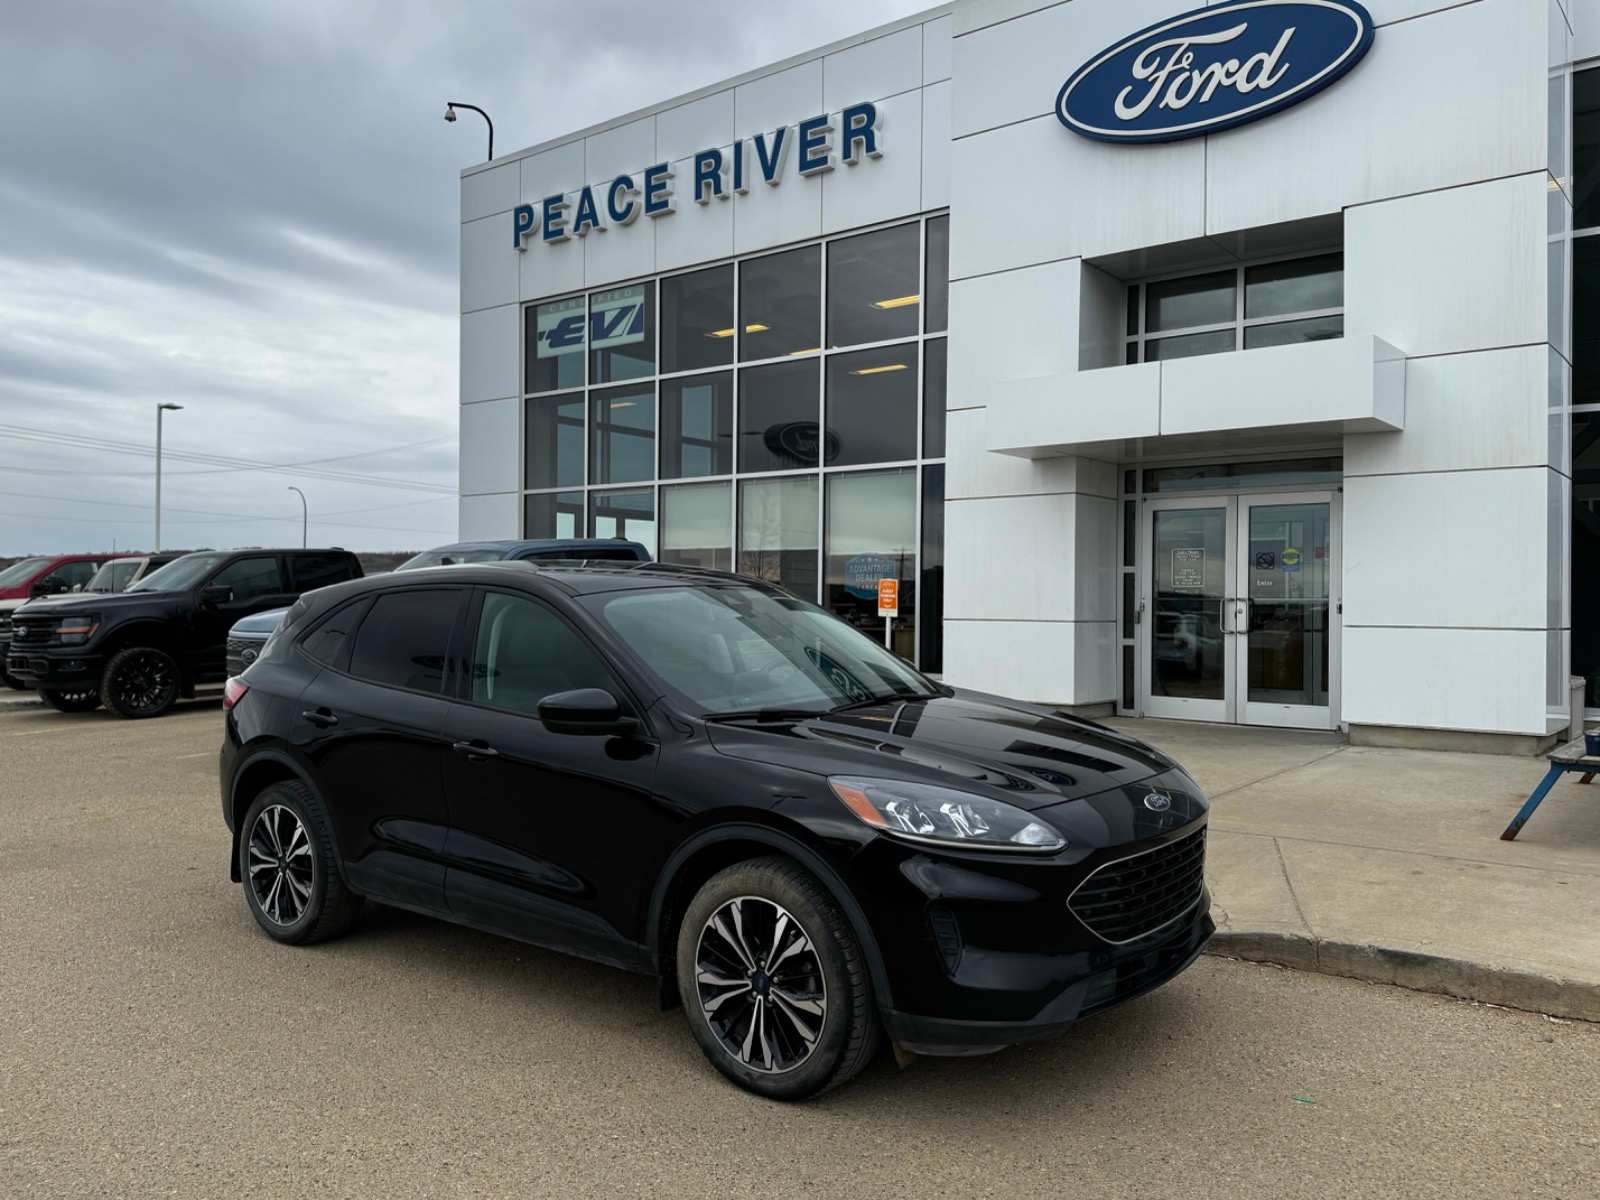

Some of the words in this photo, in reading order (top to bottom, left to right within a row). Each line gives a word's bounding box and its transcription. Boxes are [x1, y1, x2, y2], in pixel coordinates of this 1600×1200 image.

[1114, 22, 1296, 120] Ford
[513, 161, 675, 250] PEACE
[694, 101, 884, 205] RIVER
